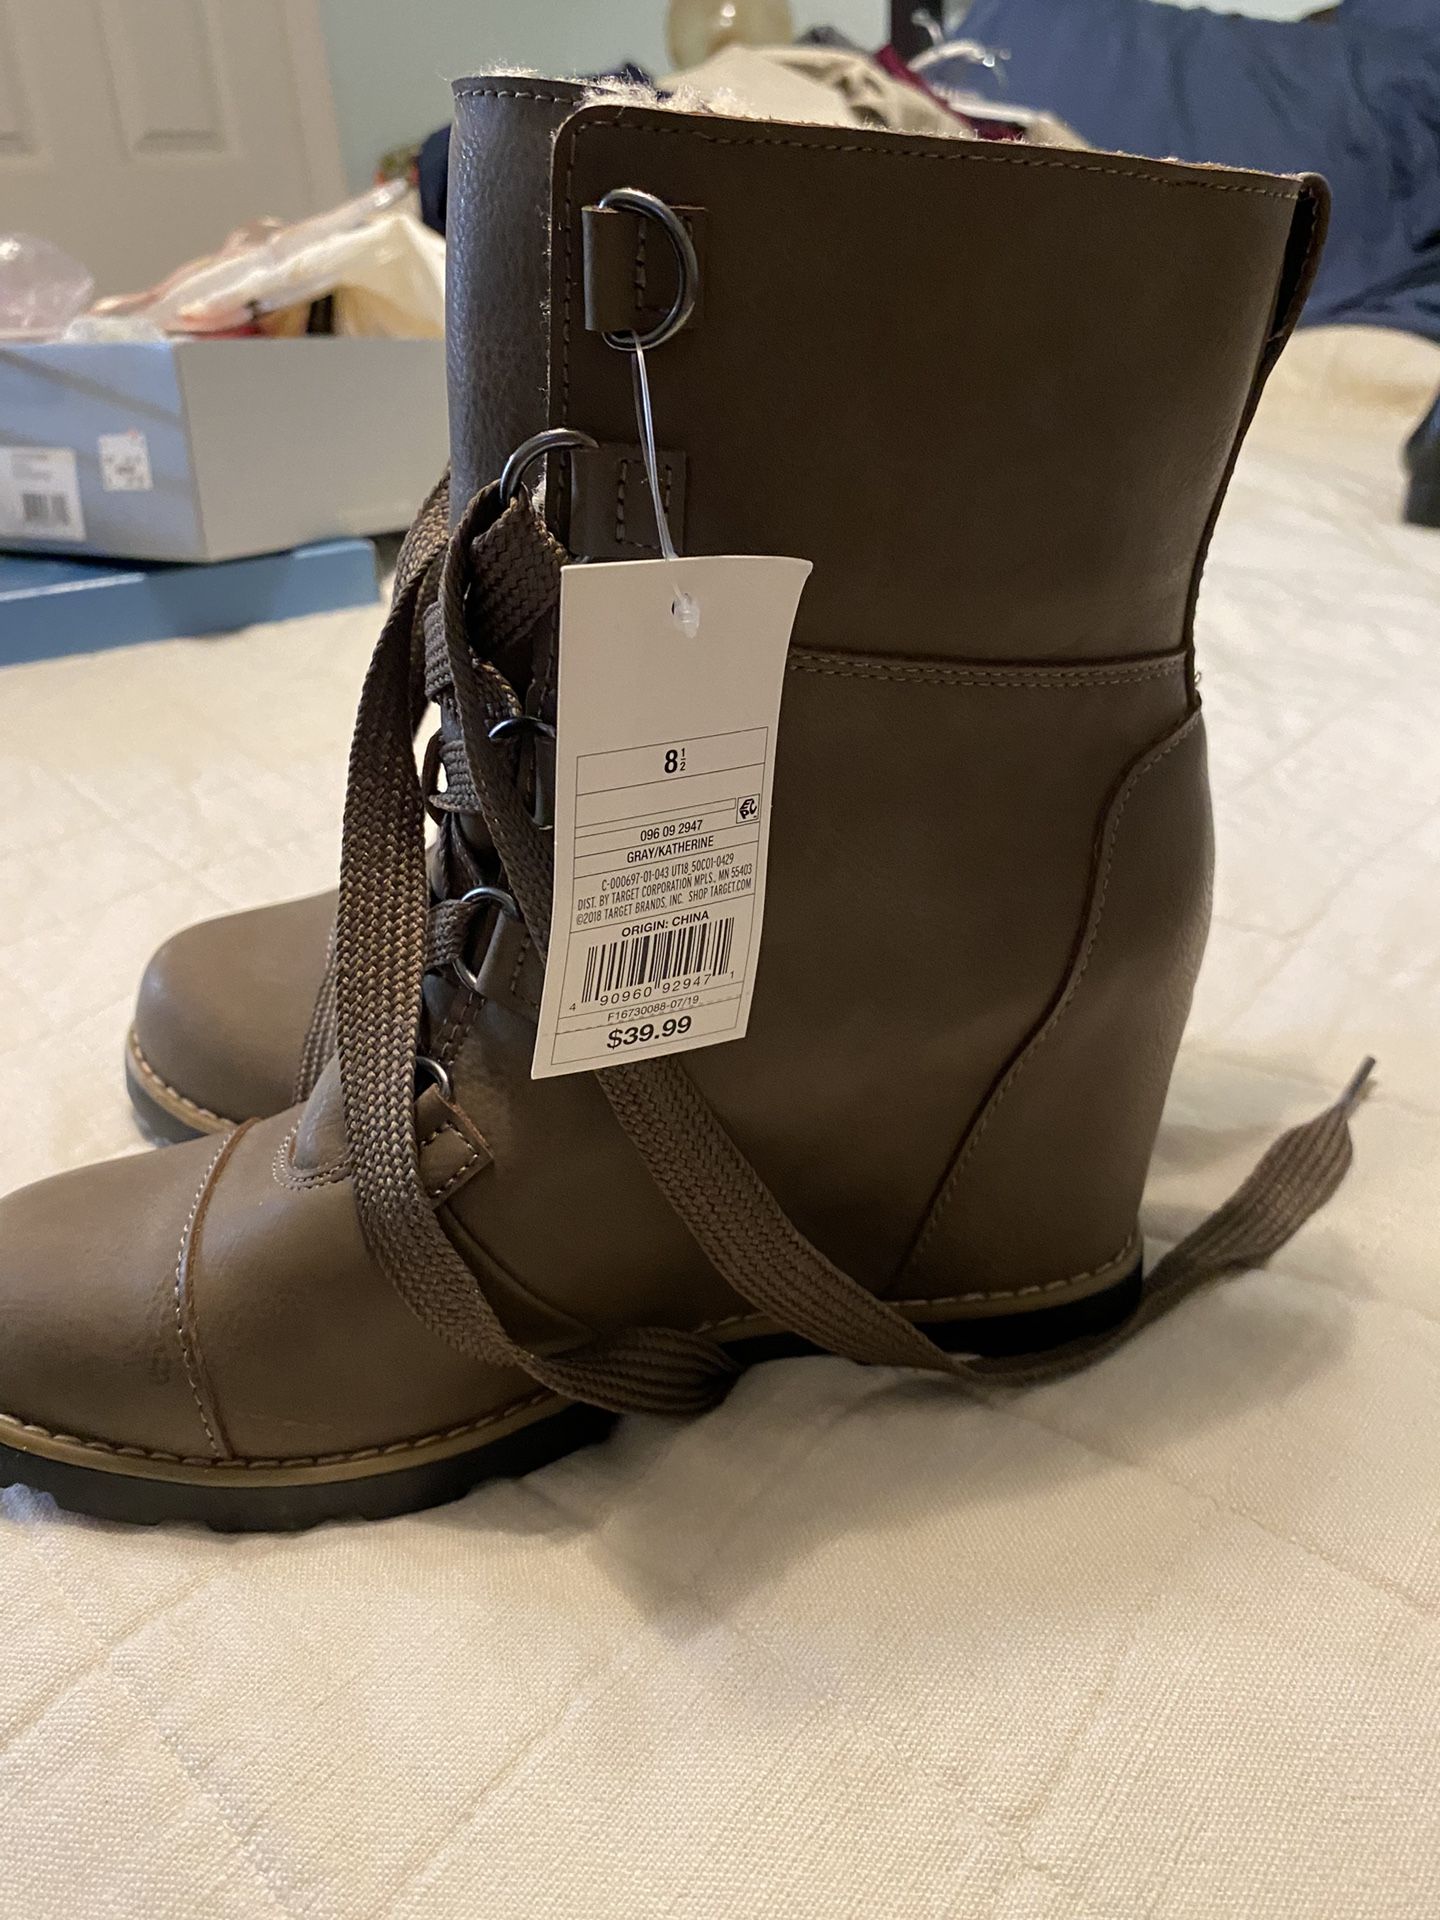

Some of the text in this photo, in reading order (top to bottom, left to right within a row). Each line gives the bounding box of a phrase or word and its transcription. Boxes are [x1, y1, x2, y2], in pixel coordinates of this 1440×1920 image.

[640, 819, 703, 842] 096 09 2947
[626, 835, 715, 863] GRAY/KATHERINE
[577, 896, 597, 911] DIST.
[599, 893, 610, 907] BY
[611, 887, 640, 905] TARGET
[641, 874, 693, 898] CORPORATION
[718, 867, 730, 881] MN
[731, 863, 753, 879] 55403
[601, 866, 670, 891] C-000697-01-043
[604, 903, 633, 920] TARGET
[688, 887, 709, 903] SHOP
[710, 877, 752, 897] TARGET.COM
[621, 909, 710, 938] ORIGIN: CHINA
[569, 1002, 577, 1012] 4
[600, 986, 653, 1006] 90960
[662, 973, 712, 994] 92947
[607, 994, 699, 1023] F16730088-07/19
[606, 1015, 692, 1050] $39.99
